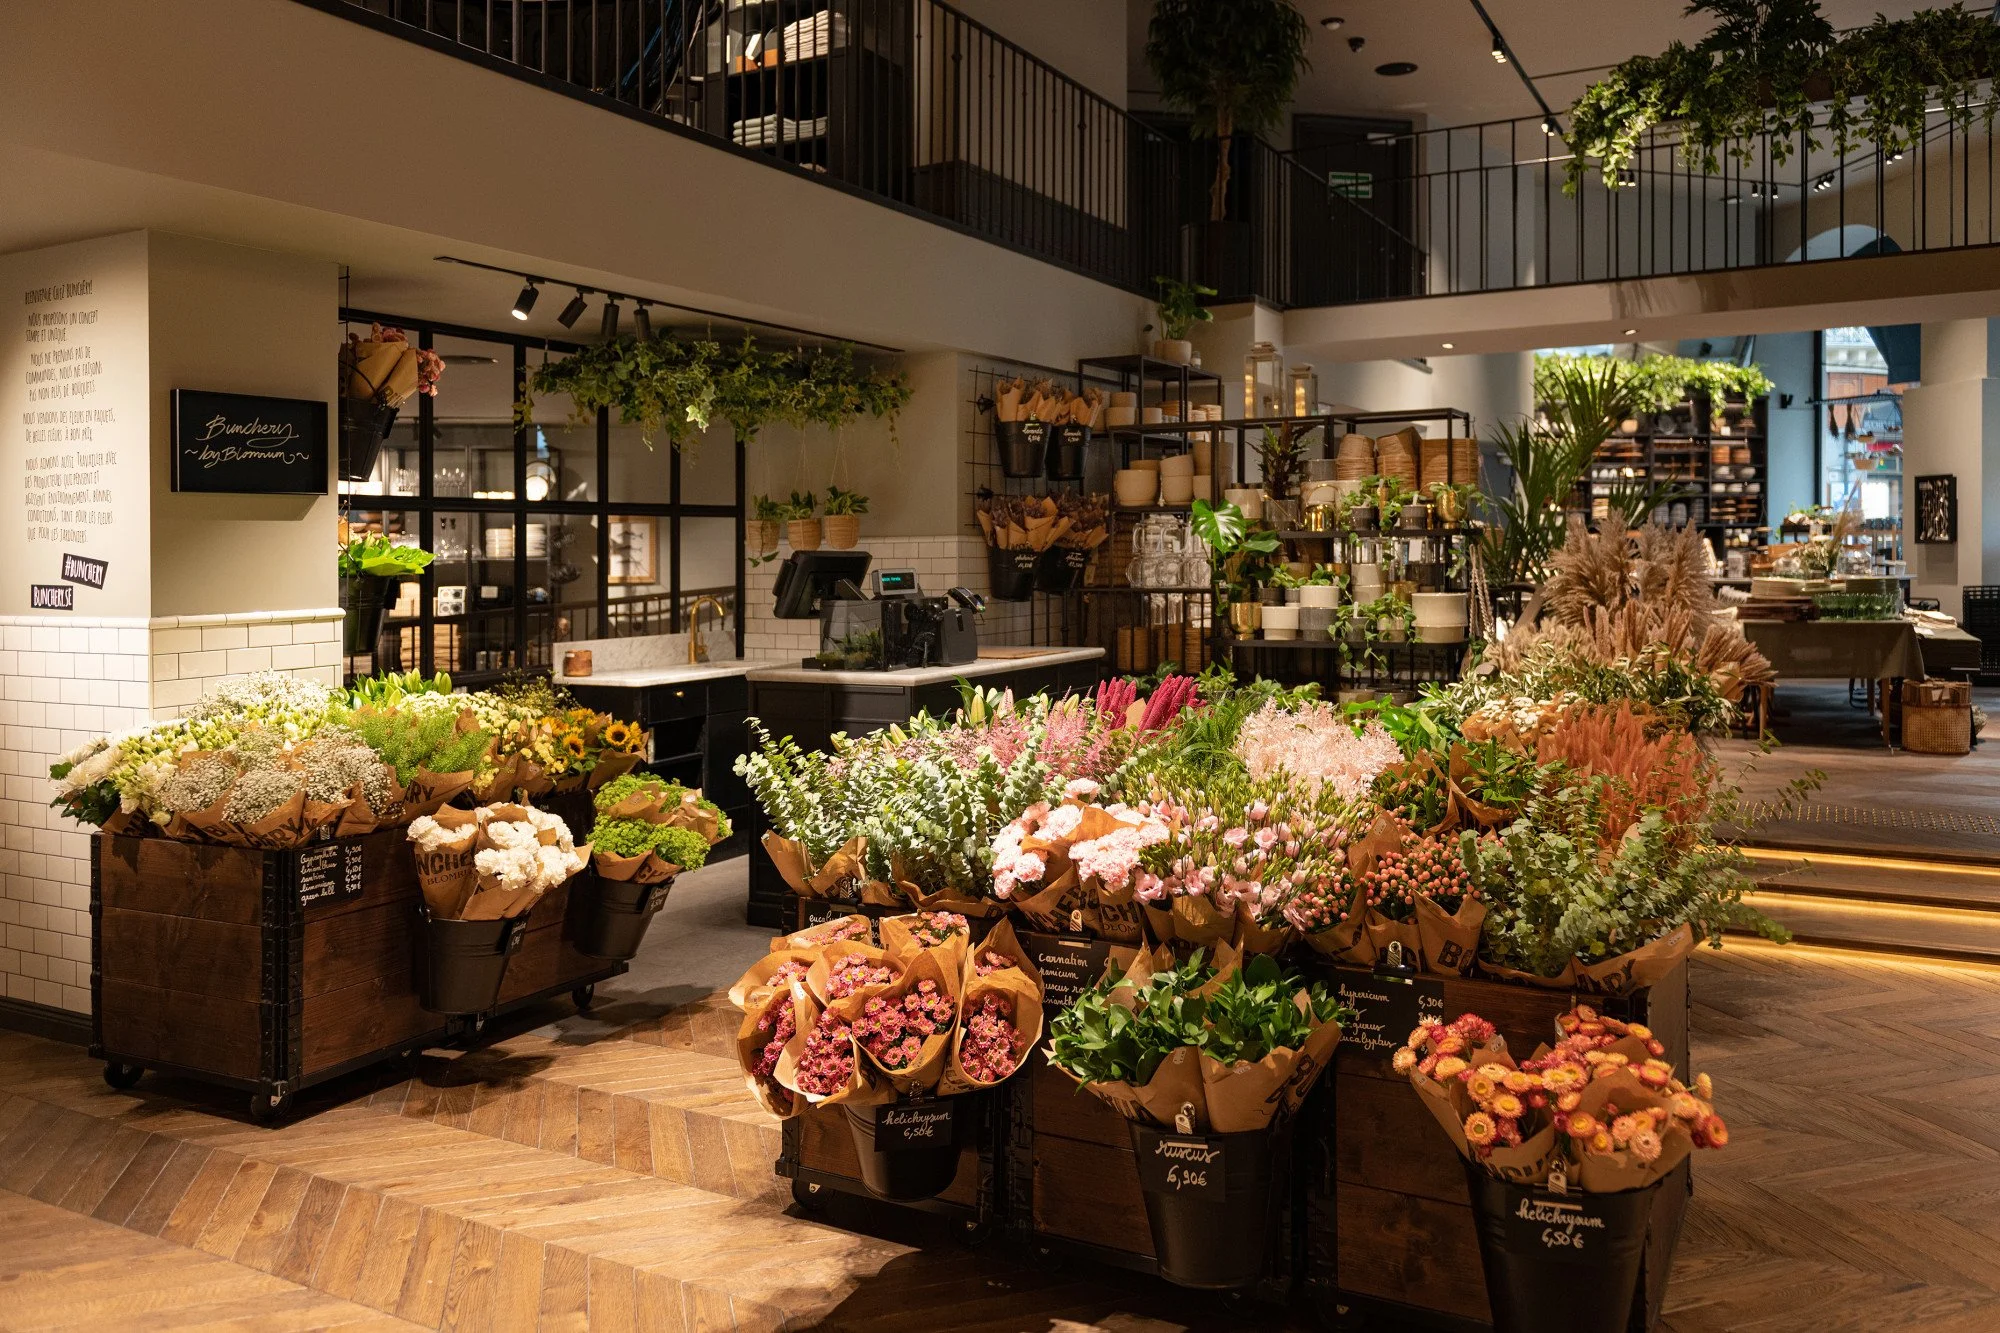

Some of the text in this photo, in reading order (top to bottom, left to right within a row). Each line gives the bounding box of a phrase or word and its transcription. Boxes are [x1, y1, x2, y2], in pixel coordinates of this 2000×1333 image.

[25, 288, 52, 304] BIENVENUE
[53, 285, 65, 301] CHEZ
[28, 310, 98, 326] NOUS PROPOSONS UN CONCEPT
[41, 329, 46, 341] ET
[31, 346, 91, 366] NOUS NE PRENONS PAS DE
[59, 365, 72, 379] NOUS
[74, 365, 81, 378] NE
[83, 361, 103, 377] FAISONS
[29, 389, 37, 402] PAS
[38, 387, 50, 400] NON
[52, 385, 62, 400] PLUS
[63, 384, 69, 397] DE
[23, 411, 36, 424] NOUS
[37, 411, 59, 424] VENDONS
[60, 410, 68, 423] DES
[69, 410, 85, 424] FLEURS
[86, 409, 93, 422] EN
[26, 429, 32, 443] DE
[33, 430, 46, 443] BELLES
[48, 428, 63, 442] FLEURS
[70, 428, 80, 441] BON
[195, 414, 300, 449] Bunchery
[25, 451, 117, 470] NOUS AIMONS AUSSI TRAVAILLER AVEC
[198, 444, 222, 469] by
[33, 473, 62, 489] PRODUCTEURS
[73, 472, 93, 486] PENSENT
[94, 470, 100, 485] ET
[25, 492, 46, 507] AGISSENT
[92, 489, 112, 504] BONNES
[61, 510, 73, 522] TANT
[75, 510, 87, 523] POUR
[88, 510, 96, 524] LES
[97, 510, 114, 525] FLEURS
[28, 527, 36, 542] QUE
[38, 526, 49, 540] POUR
[51, 528, 59, 541] LES
[65, 555, 104, 585] #BUNCHERY
[33, 586, 72, 608] BUNCHERY.SE
[1038, 967, 1080, 980] panicum
[1043, 983, 1070, 993] uscus
[1338, 983, 1444, 1010] hypericum 6,90€
[881, 1110, 952, 1130] helichrysum
[903, 1126, 934, 1139] 6,50€
[1155, 1140, 1220, 1164] ruscus
[1166, 1164, 1208, 1190] 6,90€
[1515, 1198, 1605, 1235] helichrysum
[1541, 1228, 1585, 1248] 6,50€
